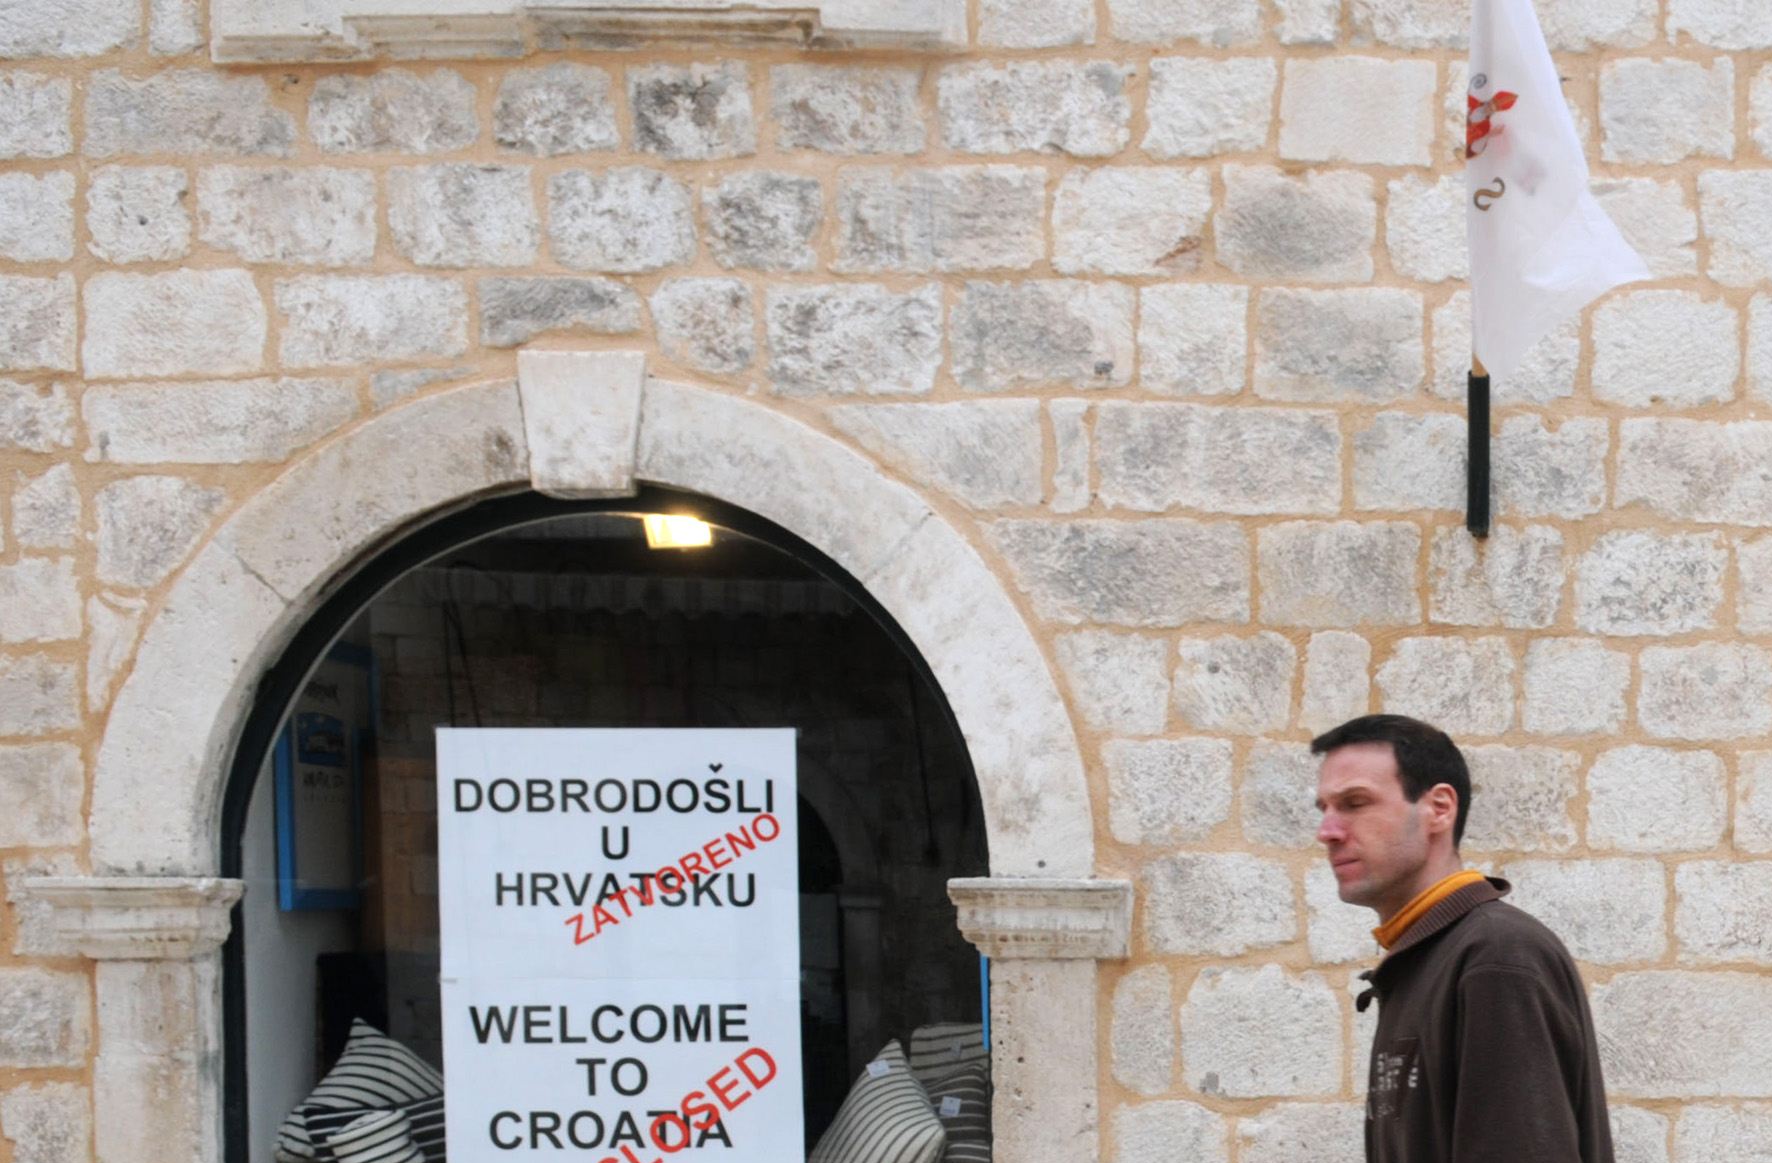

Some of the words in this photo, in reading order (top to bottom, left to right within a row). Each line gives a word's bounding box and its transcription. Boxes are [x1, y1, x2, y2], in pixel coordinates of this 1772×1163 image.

[454, 763, 775, 814] DOBRODOŠLI
[602, 827, 629, 860] U
[495, 872, 757, 908] HRVATSKU
[566, 813, 780, 945] ZATVORENO
[469, 1004, 749, 1044] WELCOME
[576, 1057, 648, 1097] TO
[489, 1110, 733, 1150] CROATIA
